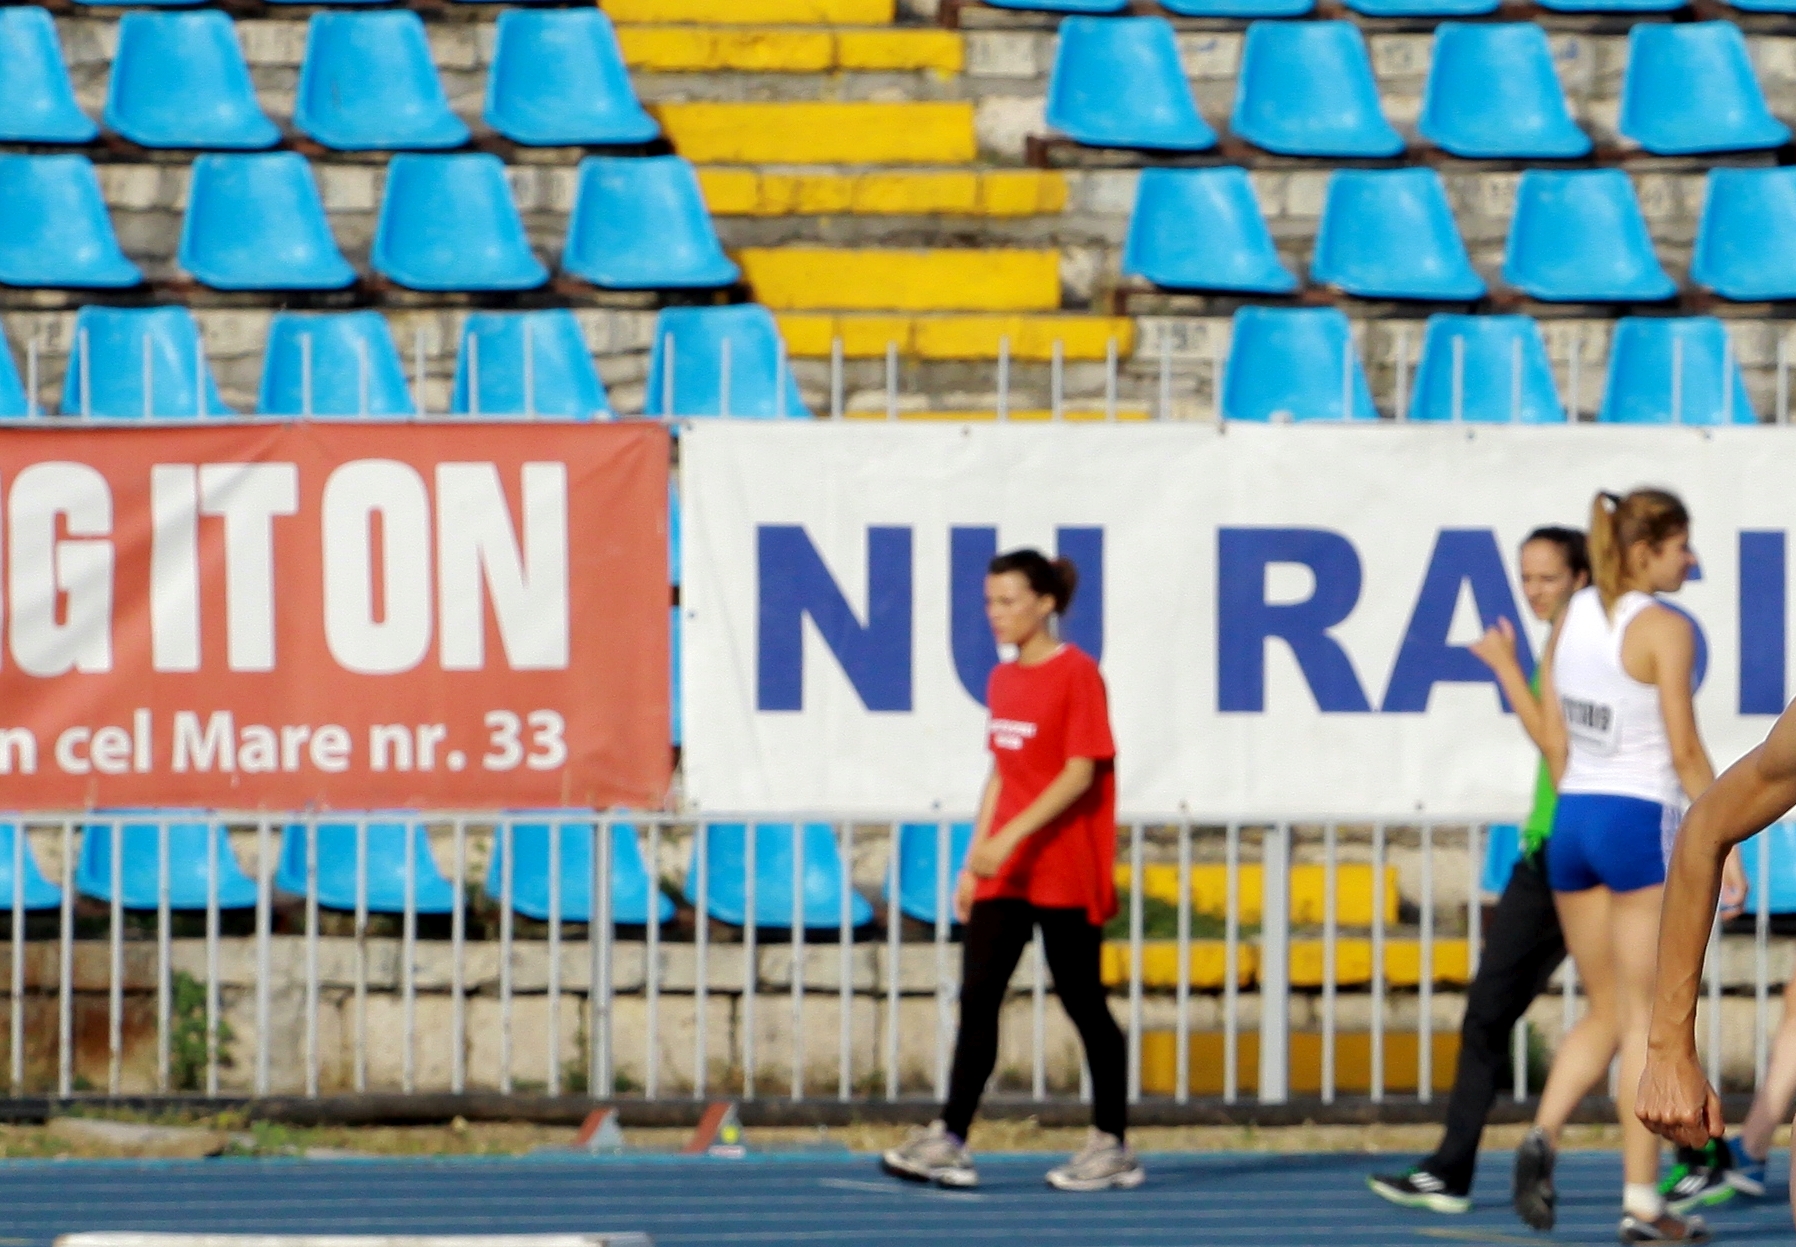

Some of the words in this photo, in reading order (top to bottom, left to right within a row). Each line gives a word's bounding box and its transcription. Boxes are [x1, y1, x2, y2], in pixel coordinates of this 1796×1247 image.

[0, 459, 114, 677] G
[150, 462, 299, 673] IT
[321, 458, 569, 675] ON
[55, 707, 152, 774] cel
[172, 713, 351, 772] Mare
[370, 731, 465, 772] nr.
[483, 711, 568, 771] 33
